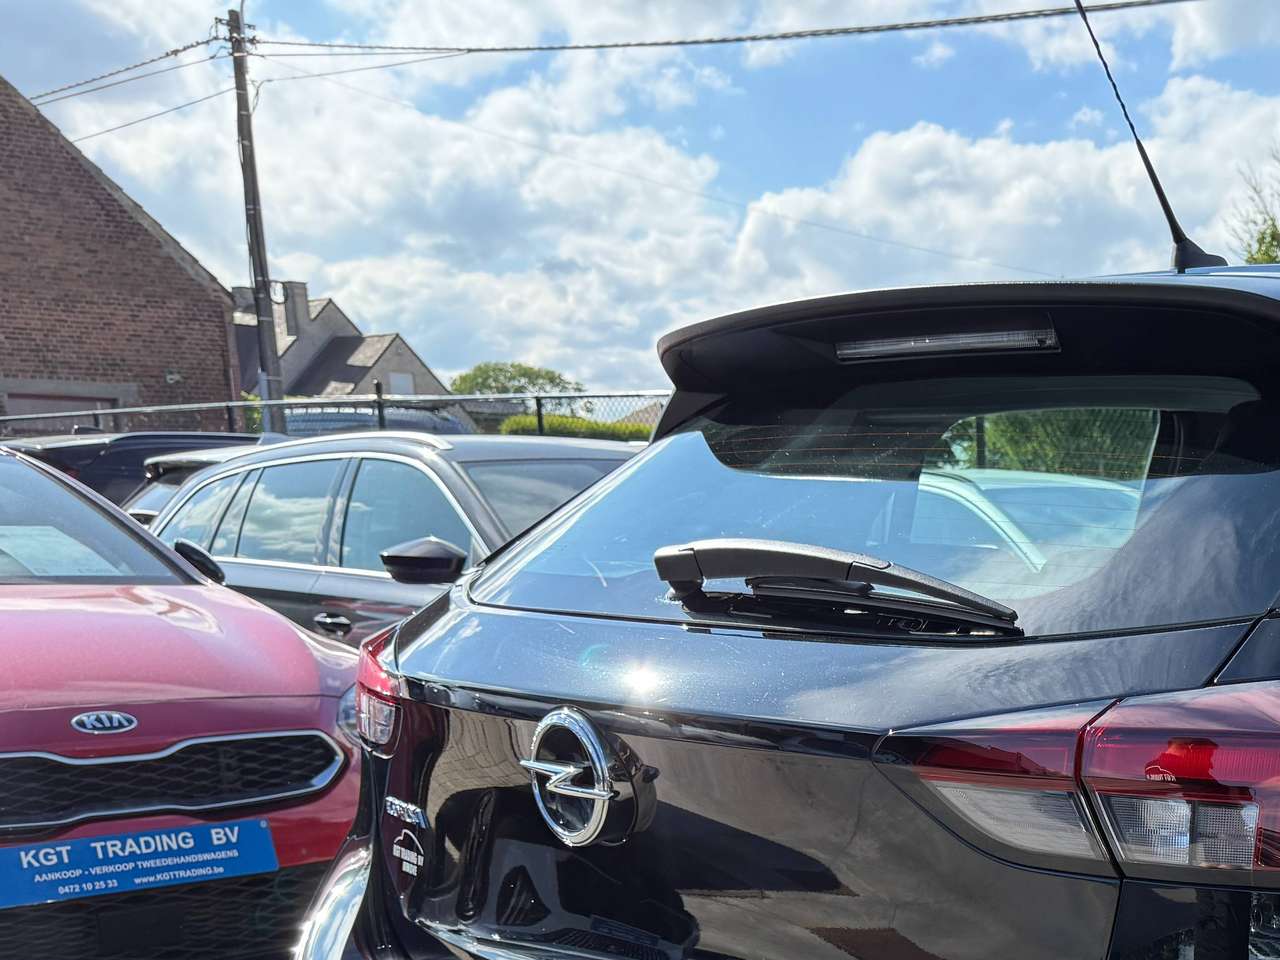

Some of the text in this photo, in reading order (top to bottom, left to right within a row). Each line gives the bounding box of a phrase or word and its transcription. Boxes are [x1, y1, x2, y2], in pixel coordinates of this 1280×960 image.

[81, 714, 130, 729] KIA
[20, 826, 239, 869] KGT TRADING BV
[34, 868, 82, 883] AANKOOP
[89, 861, 135, 876] VERKOOP
[136, 848, 239, 869] TWEEDEHANDSWAGENS
[133, 865, 225, 885] www.KGTTRADING.be
[58, 884, 80, 895] 0472
[82, 882, 93, 892] 10
